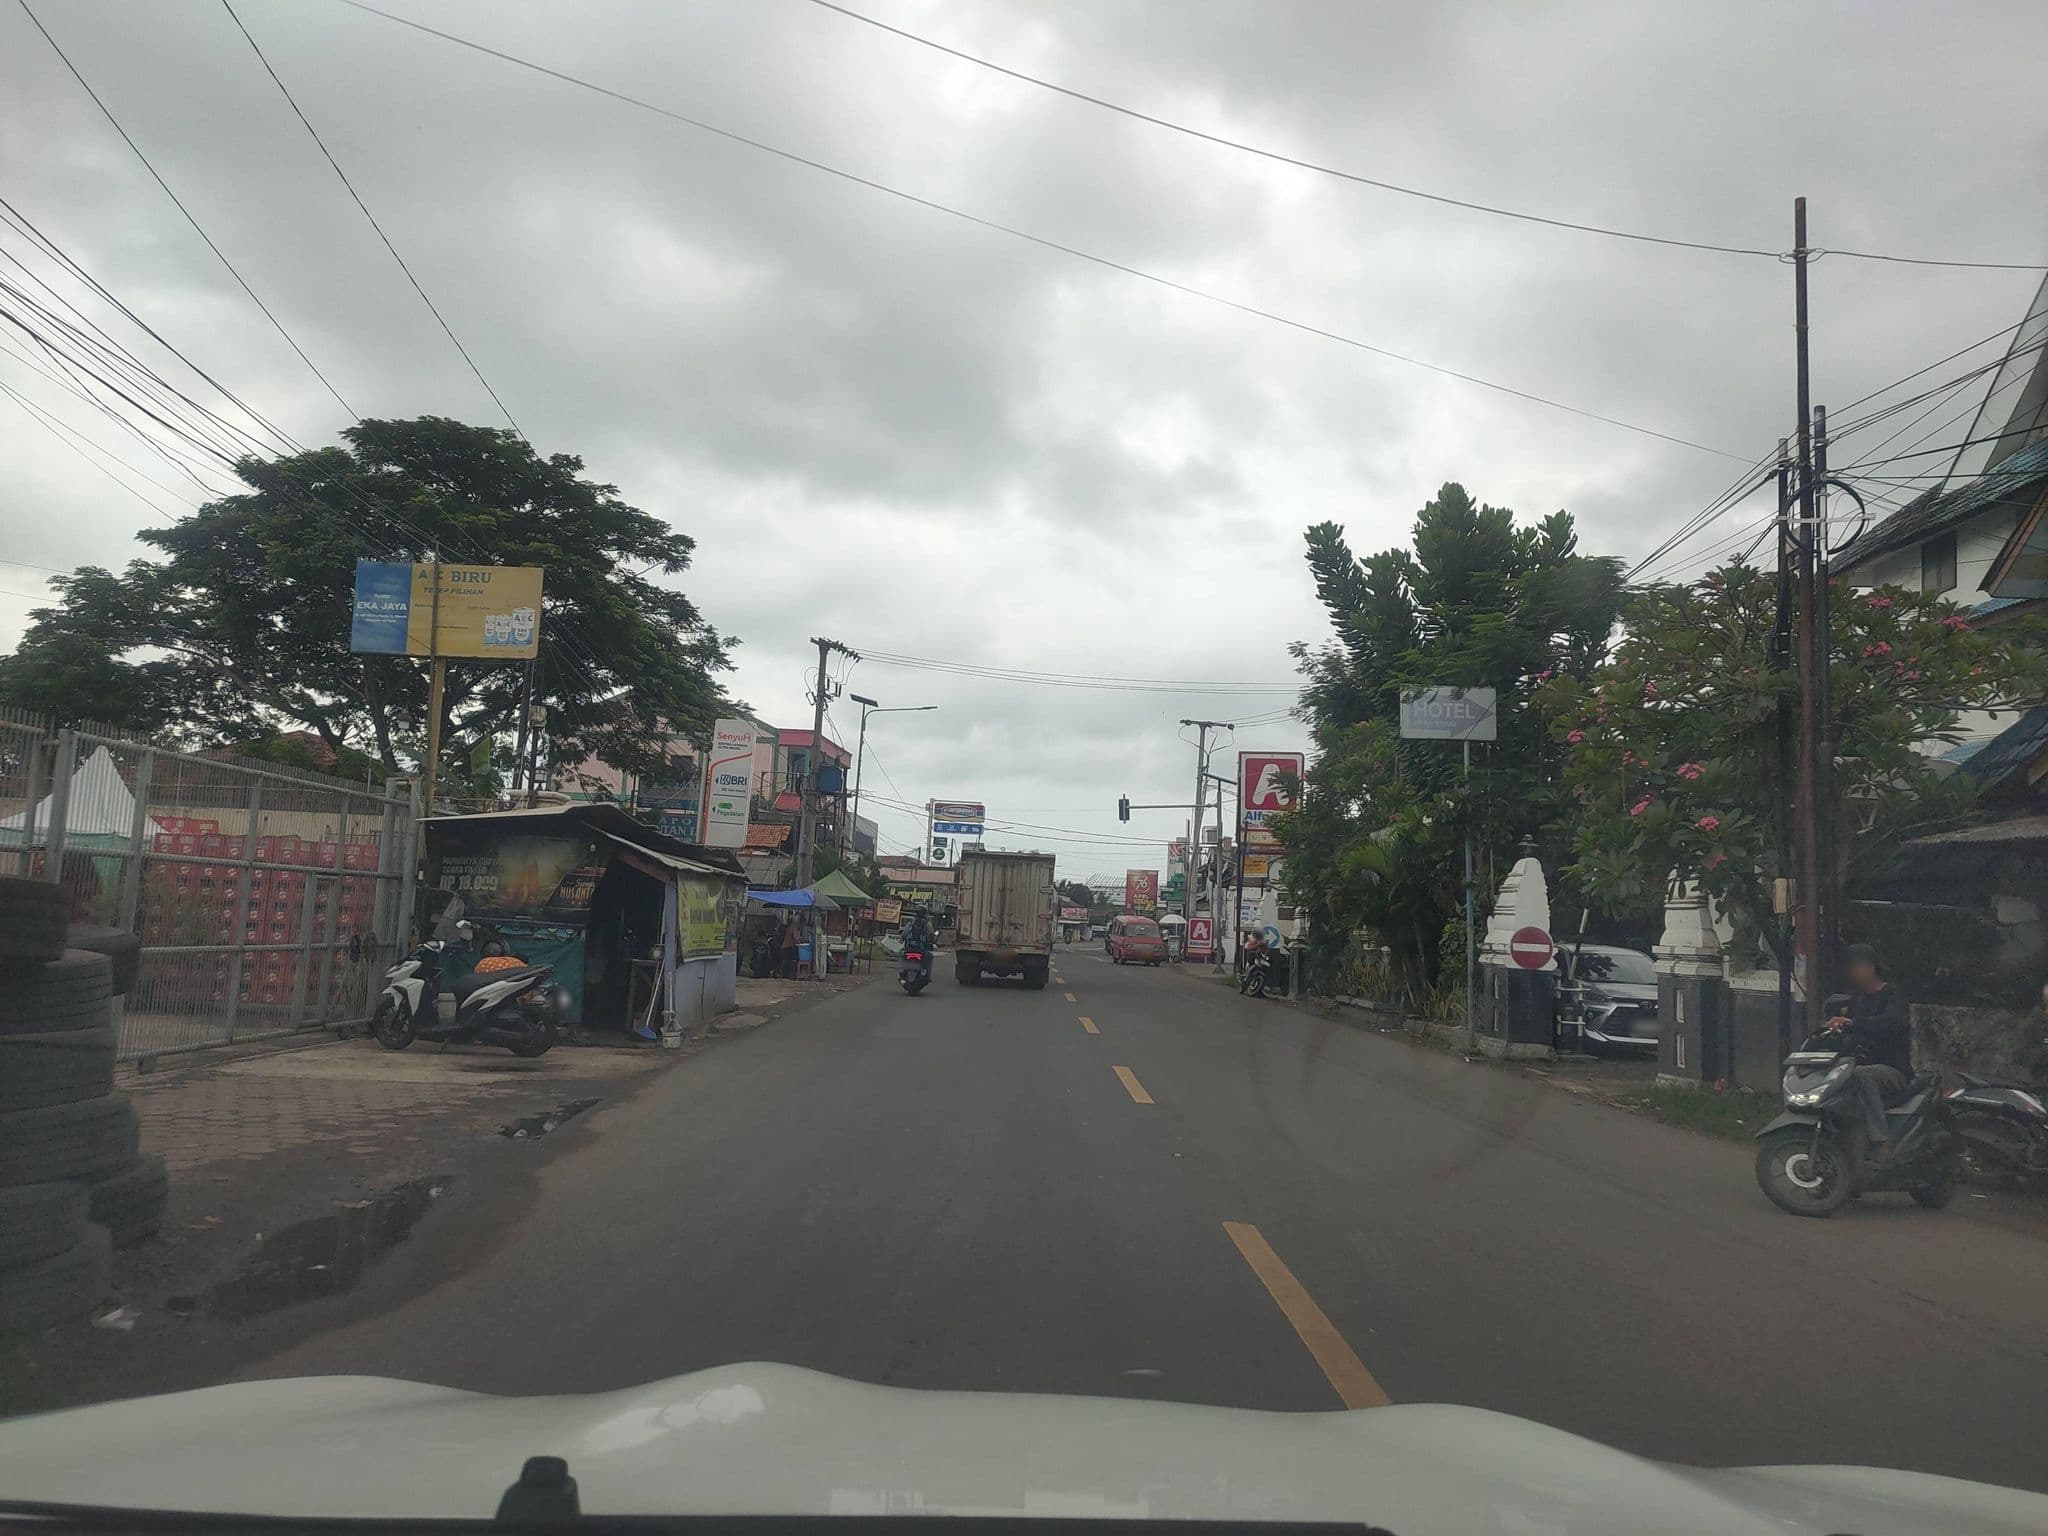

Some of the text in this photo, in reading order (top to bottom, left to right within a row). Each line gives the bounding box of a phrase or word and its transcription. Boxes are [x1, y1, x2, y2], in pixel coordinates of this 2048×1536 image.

[450, 571, 492, 584] BIRU
[356, 601, 378, 610] EKA
[380, 602, 408, 611] JAYA
[1412, 701, 1476, 719] HOTEL
[731, 776, 747, 786] BRI
